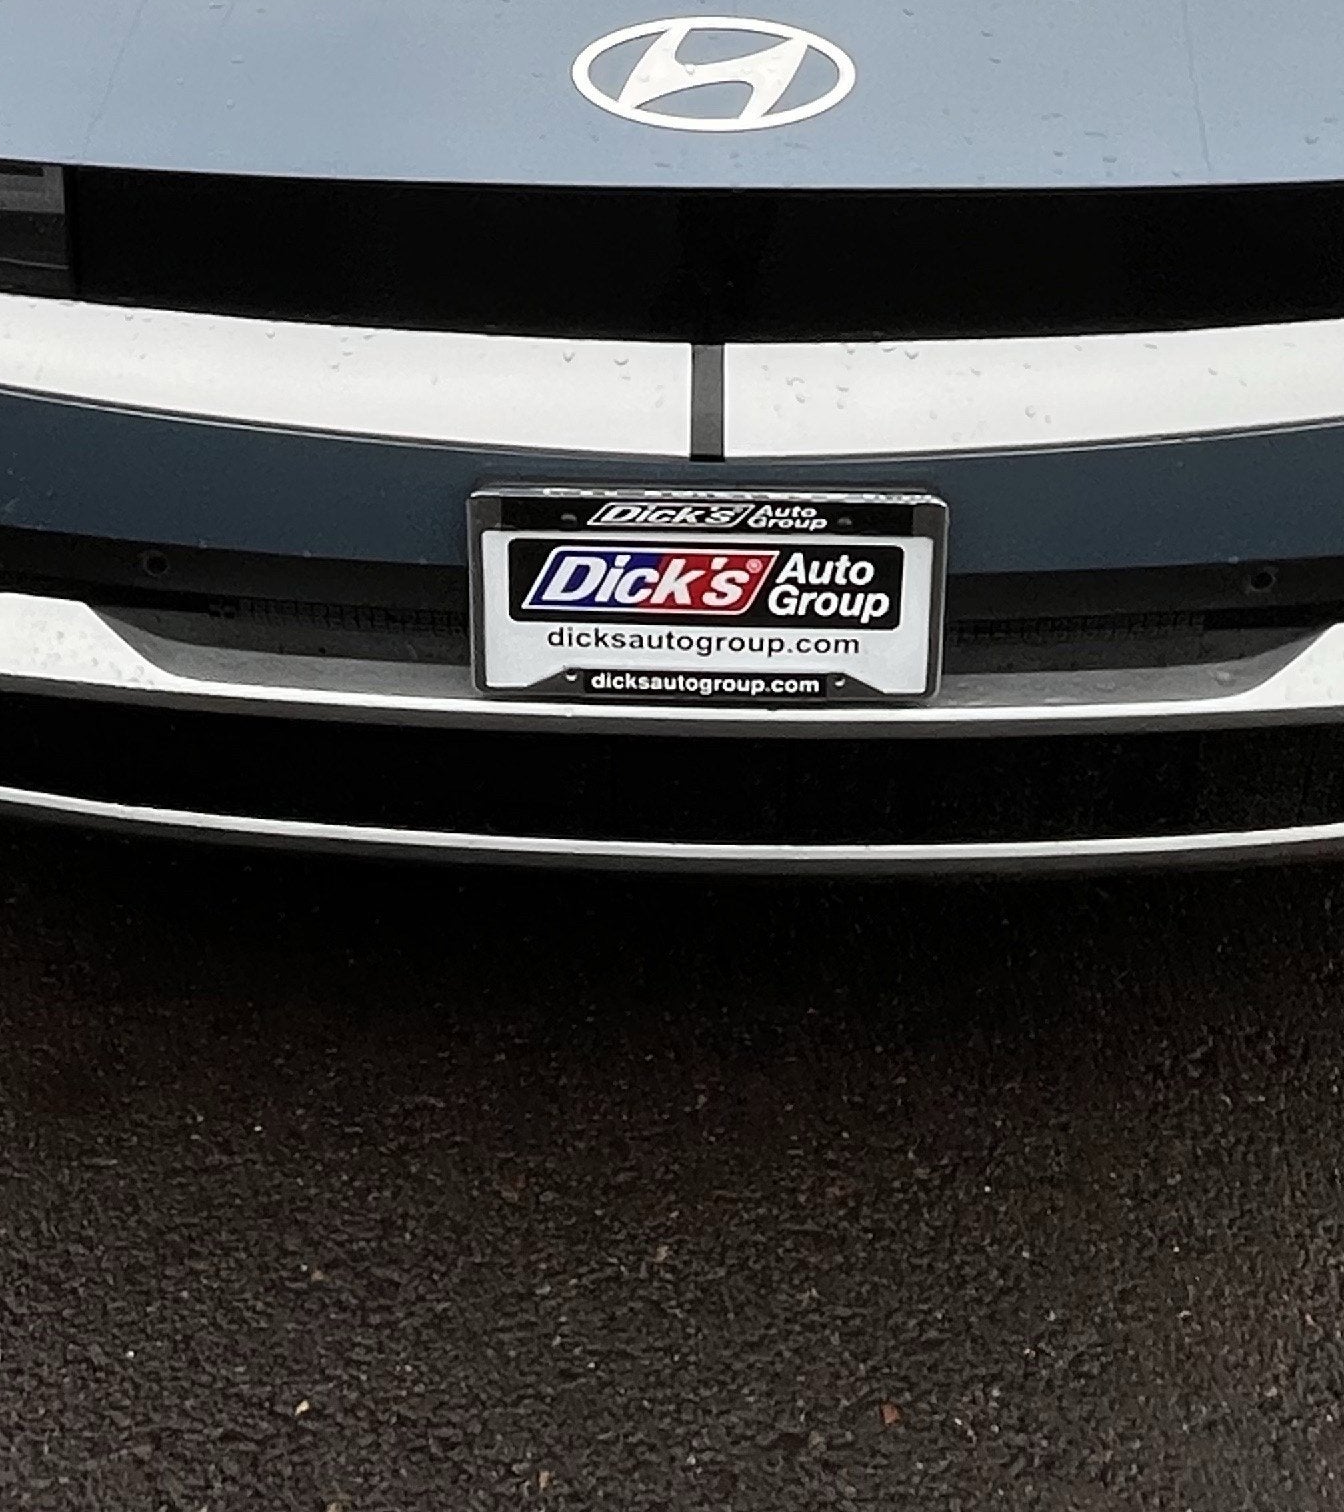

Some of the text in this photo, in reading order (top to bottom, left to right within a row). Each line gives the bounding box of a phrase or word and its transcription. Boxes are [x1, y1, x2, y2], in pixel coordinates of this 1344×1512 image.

[747, 518, 828, 531] Group
[756, 505, 818, 518] Auto
[773, 552, 875, 586] Auto
[767, 585, 891, 624] Group
[547, 627, 860, 658] dicksautogroup.com
[591, 672, 820, 695] dicksautogroup.com
